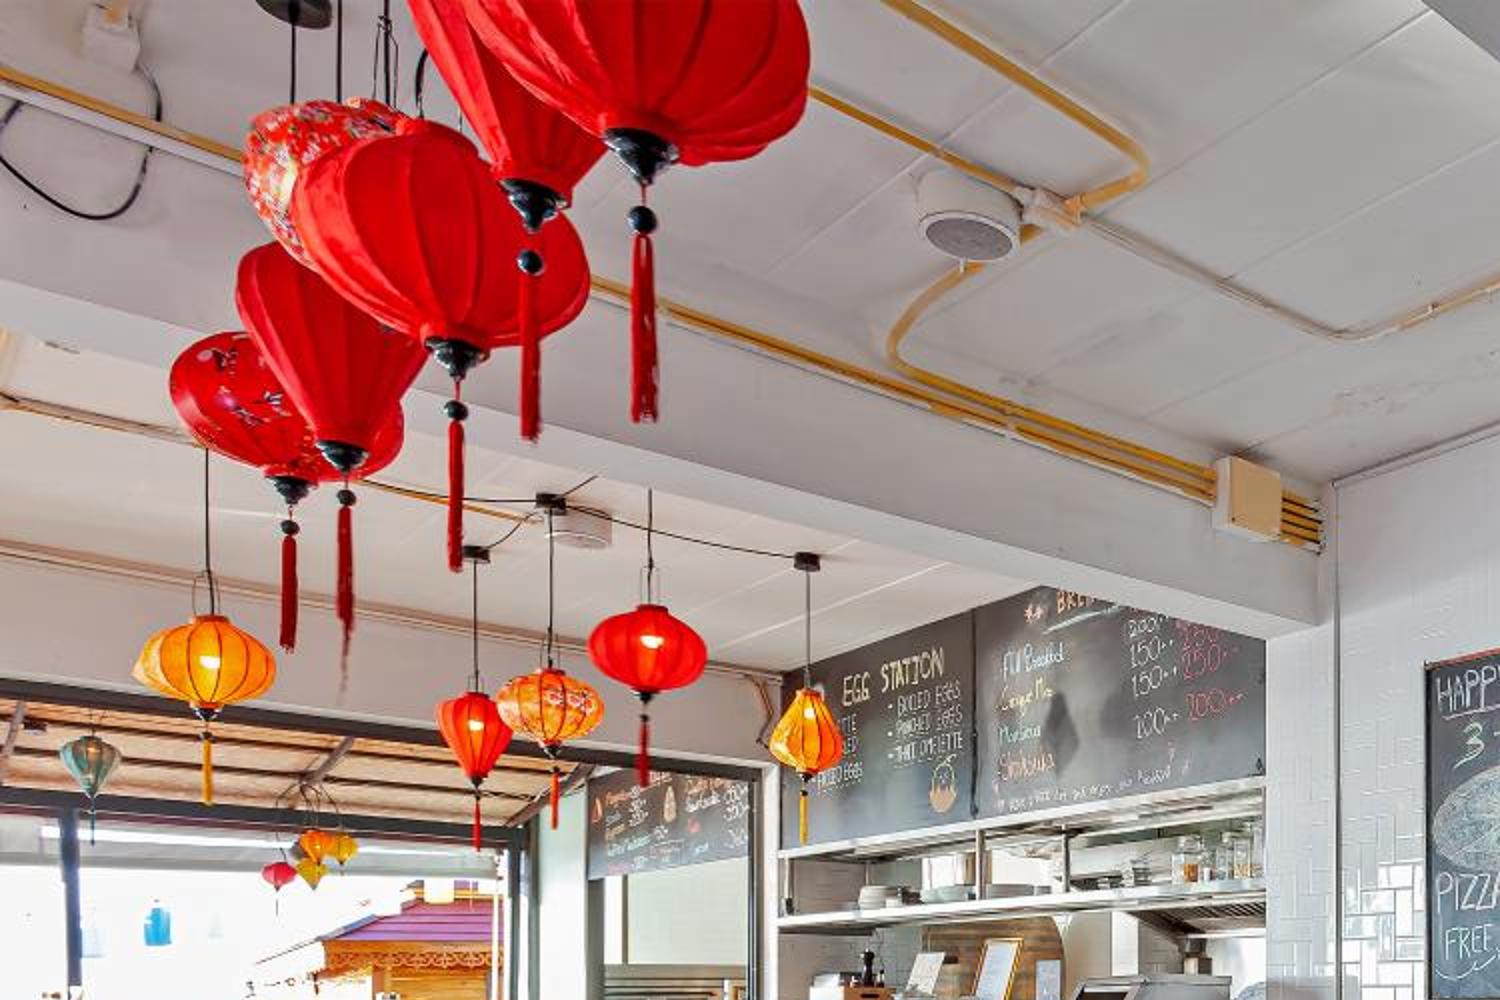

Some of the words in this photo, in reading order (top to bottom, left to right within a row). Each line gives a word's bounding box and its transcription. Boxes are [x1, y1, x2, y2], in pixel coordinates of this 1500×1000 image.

[843, 671, 871, 707] EGG
[881, 647, 944, 693] STATION
[1445, 923, 1494, 960] FREE
